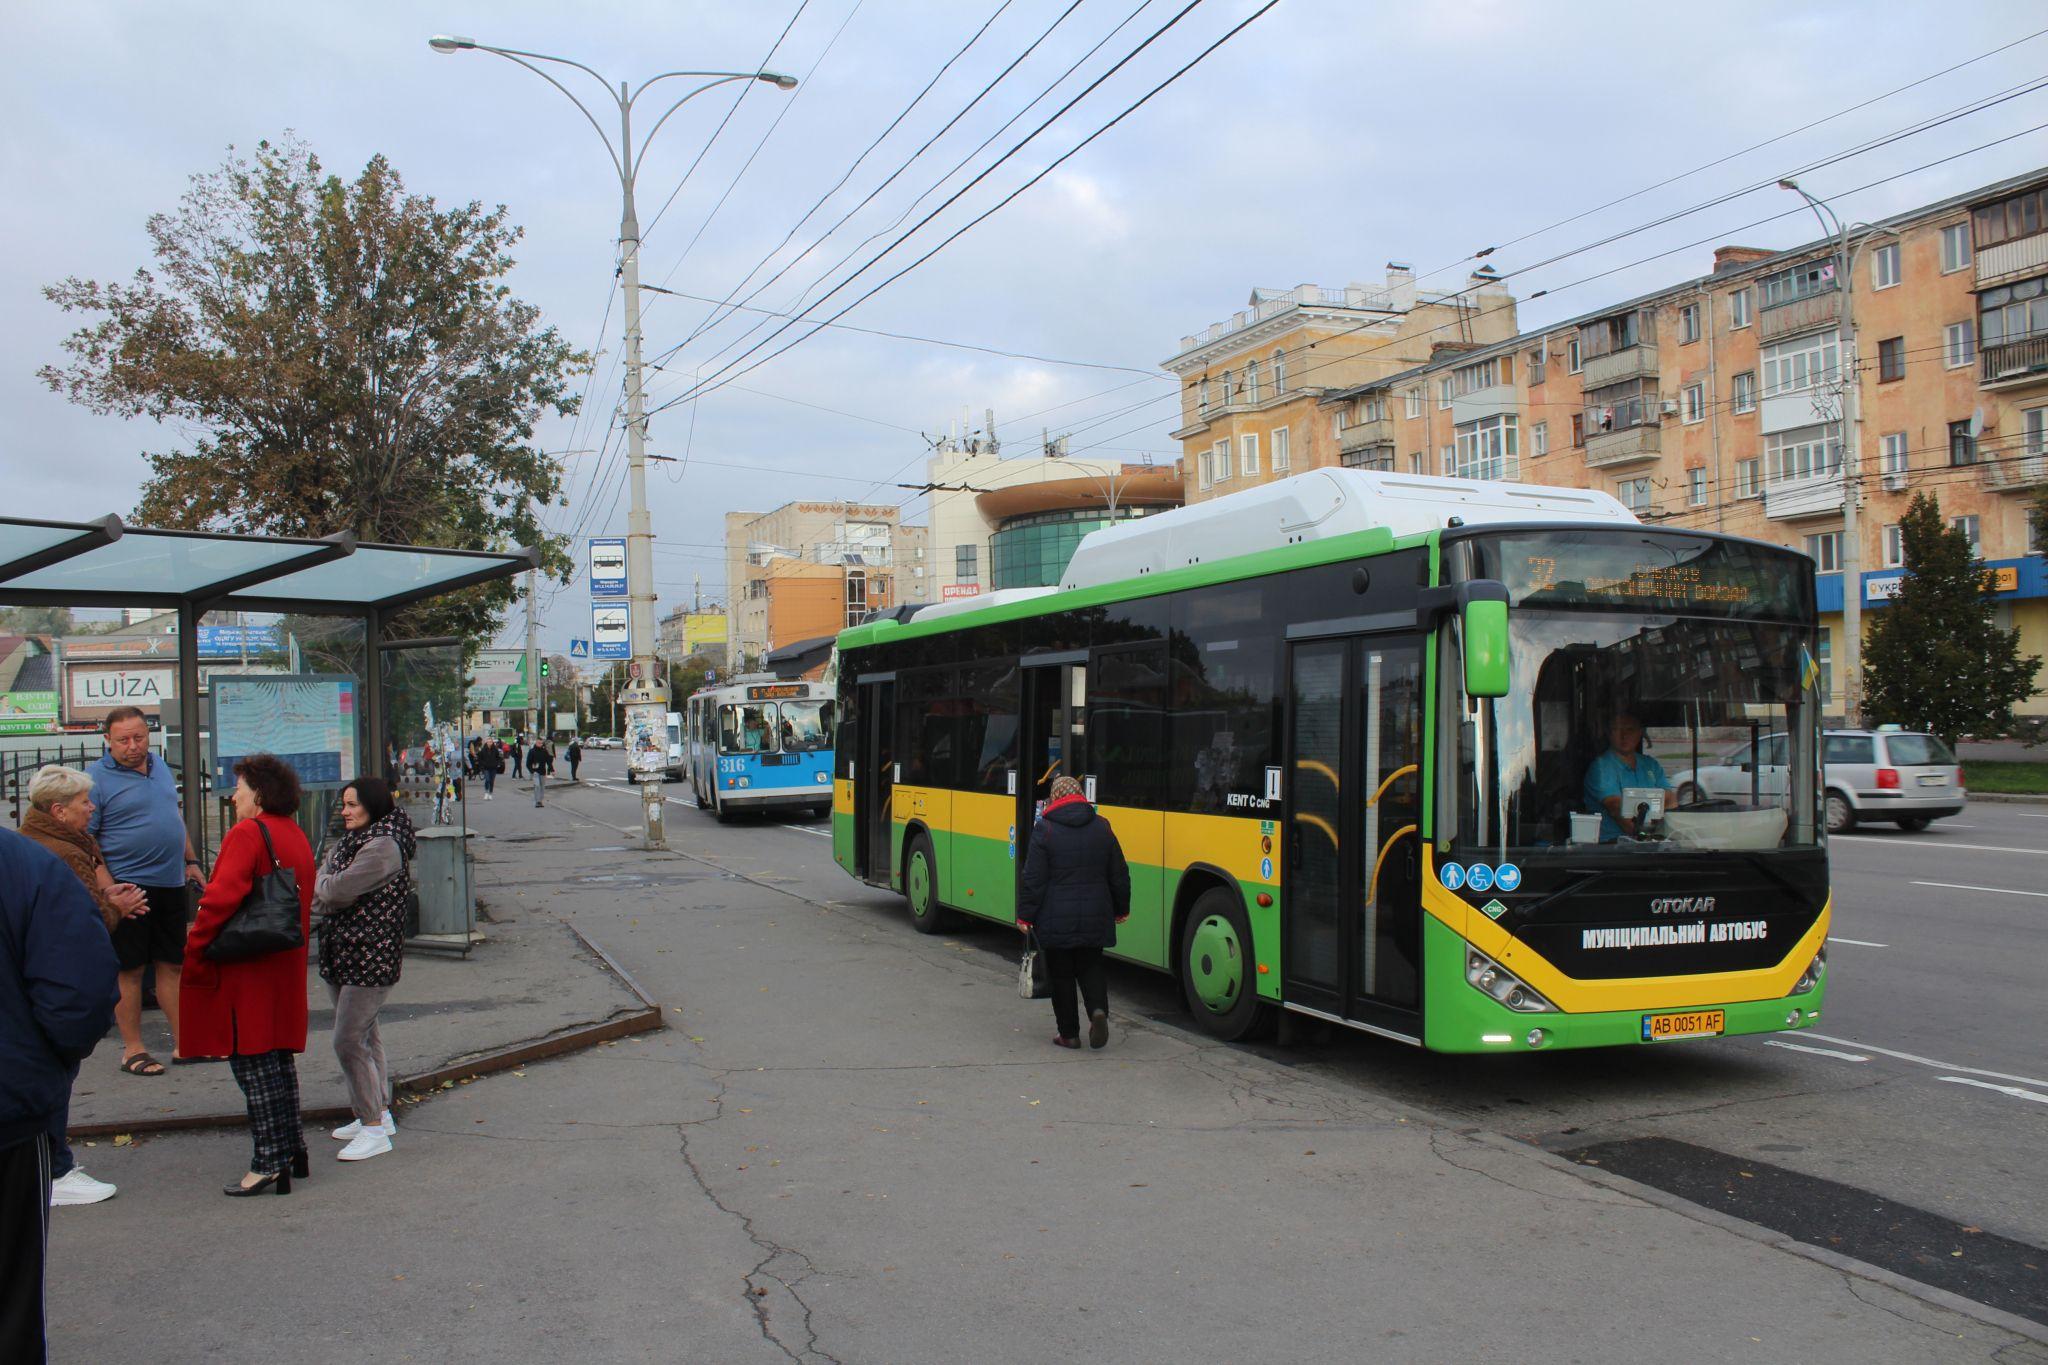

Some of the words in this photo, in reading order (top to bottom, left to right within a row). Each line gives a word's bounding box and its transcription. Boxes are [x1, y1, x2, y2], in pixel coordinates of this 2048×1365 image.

[720, 758, 745, 773] 316
[1227, 793, 1249, 807] KENT
[1249, 794, 1256, 807] C
[1256, 798, 1270, 808] CNG
[1651, 897, 1715, 914] OTOKAR
[1582, 920, 1705, 949] МУНІЦИПАЛЬНИЙ
[1709, 920, 1768, 942] АВТОБУС
[1654, 1018, 1671, 1034] AB
[1674, 1016, 1702, 1032] 0051
[1706, 1014, 1721, 1029] AF
